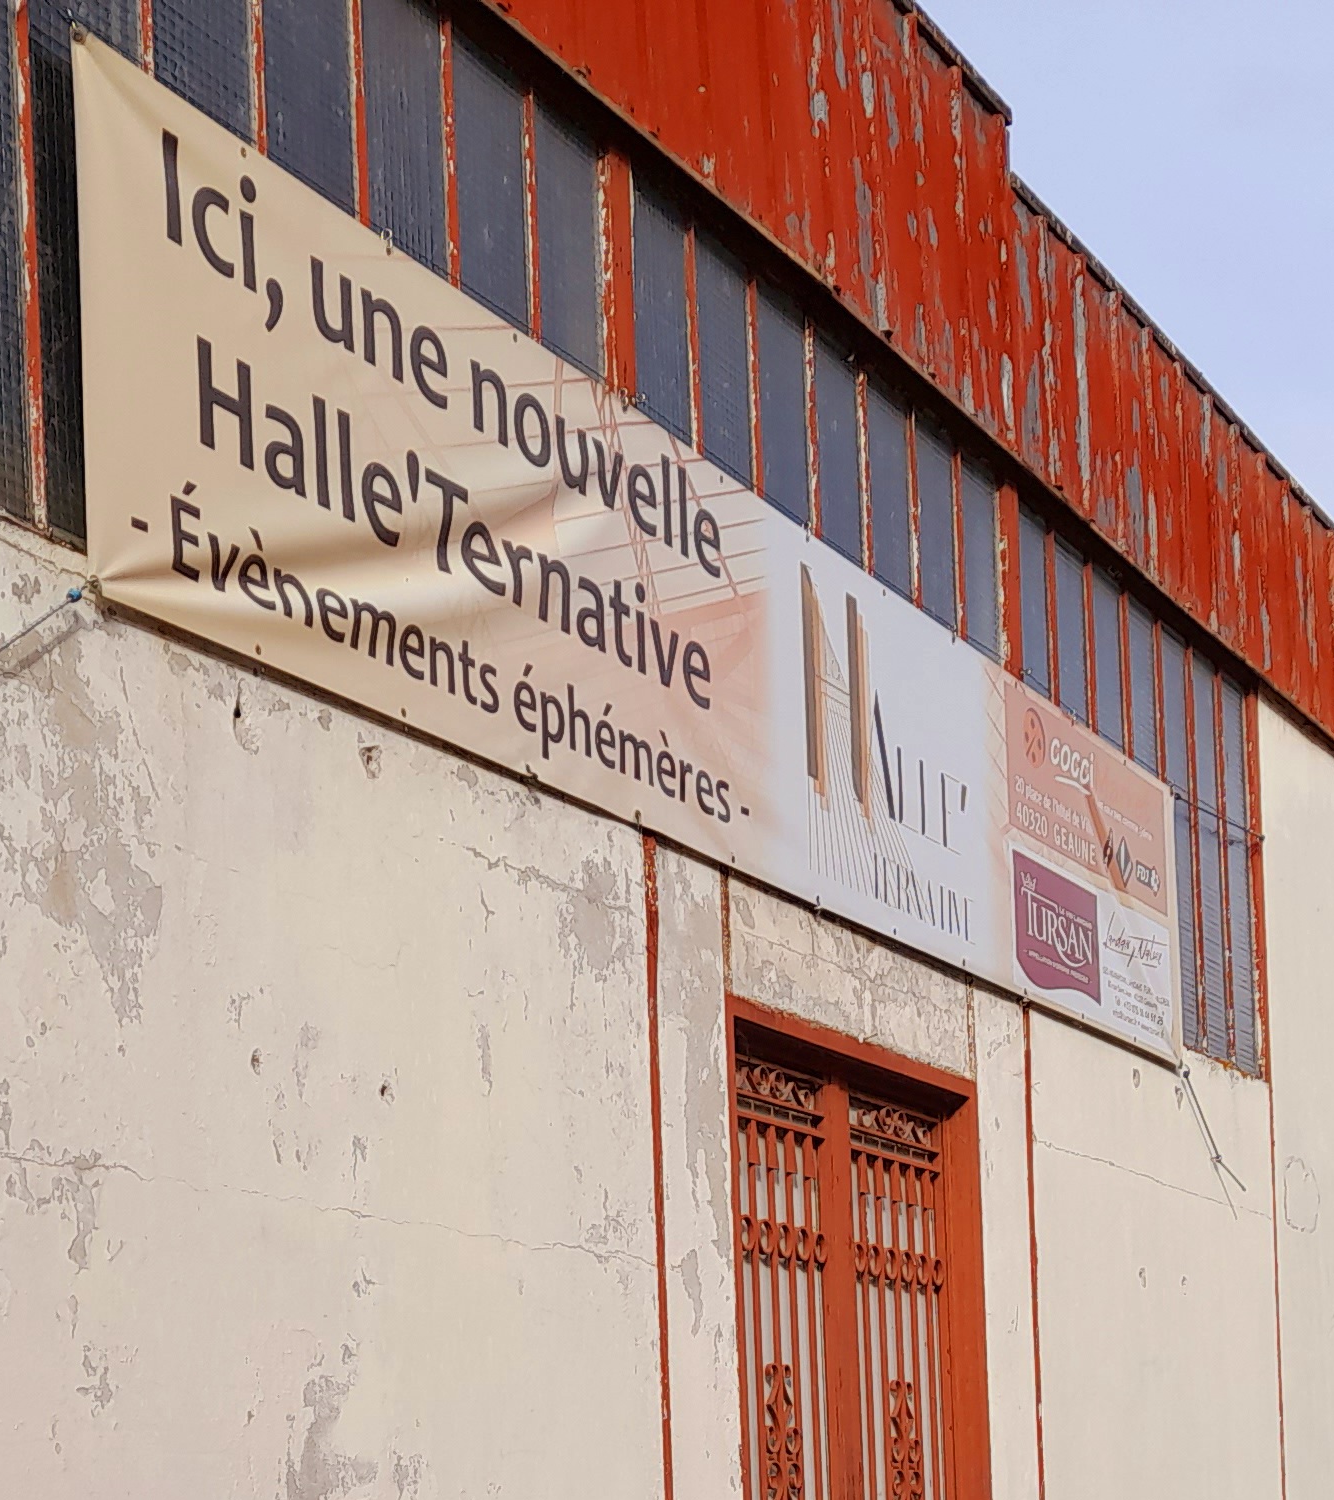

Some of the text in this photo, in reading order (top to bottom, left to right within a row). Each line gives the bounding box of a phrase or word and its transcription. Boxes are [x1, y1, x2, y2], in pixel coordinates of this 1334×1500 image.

[162, 128, 722, 579] Ici, une nouvelle
[196, 335, 712, 710] Halle'Ternative
[170, 481, 500, 715] Évènements
[513, 663, 732, 823] éphémères
[1016, 801, 1048, 838] 40320
[1053, 823, 1097, 866] GEAUNE
[1020, 886, 1093, 967] TURSAN
